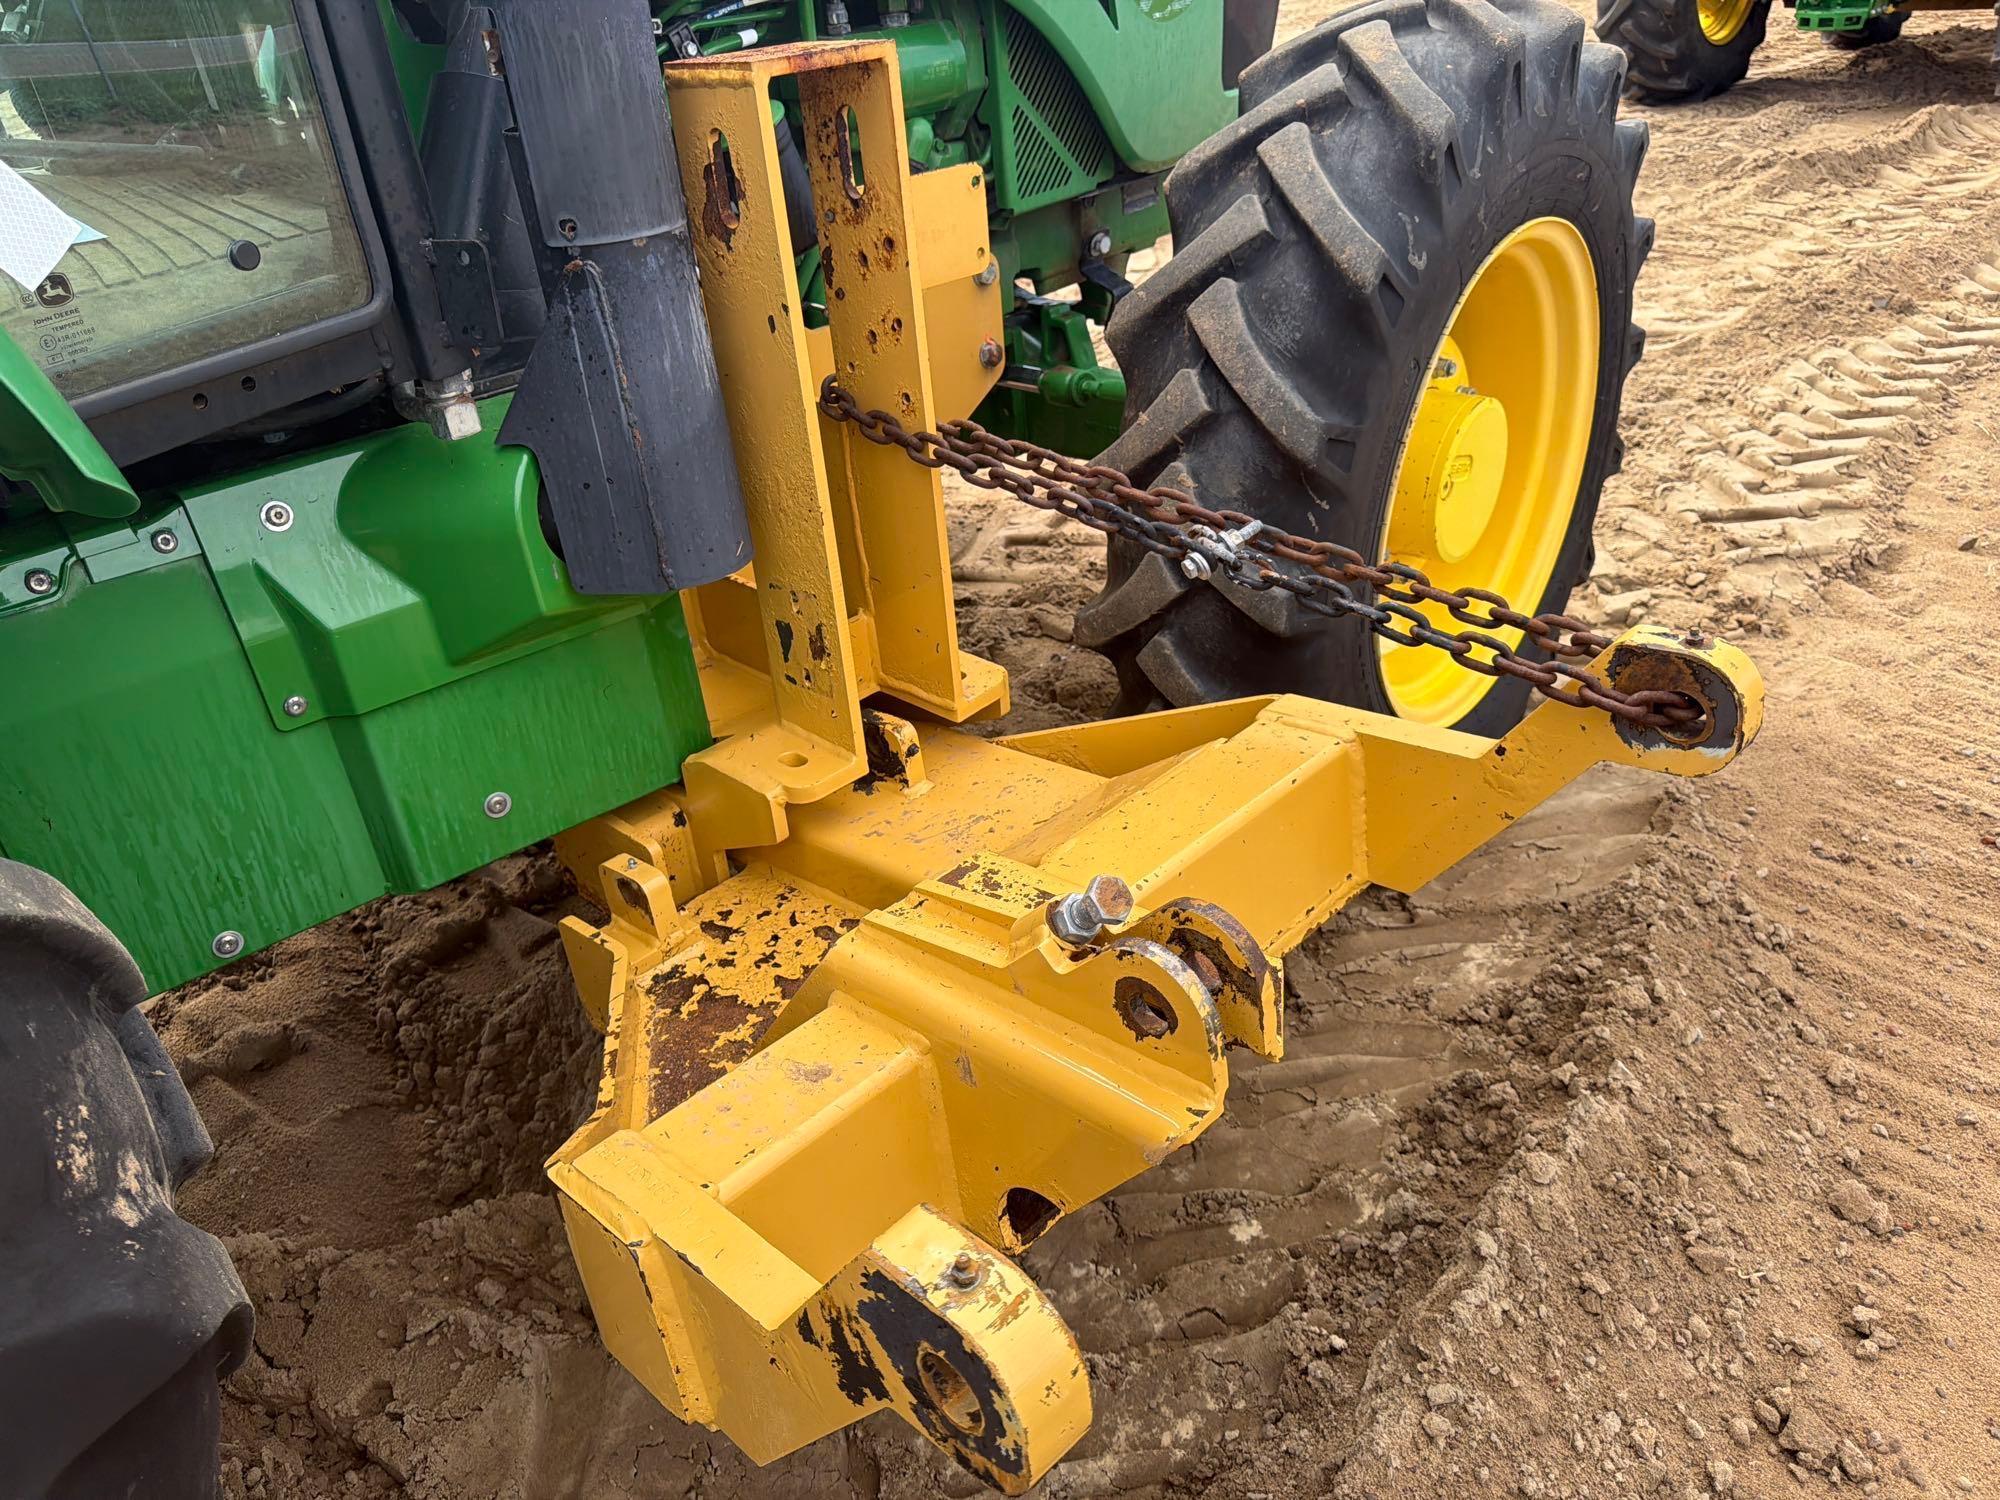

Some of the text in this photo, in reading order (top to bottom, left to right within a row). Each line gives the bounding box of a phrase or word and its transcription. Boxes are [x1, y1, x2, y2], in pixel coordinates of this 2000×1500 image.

[33, 307, 80, 326] JOHN DEERE
[52, 319, 84, 333] TEMPERED
